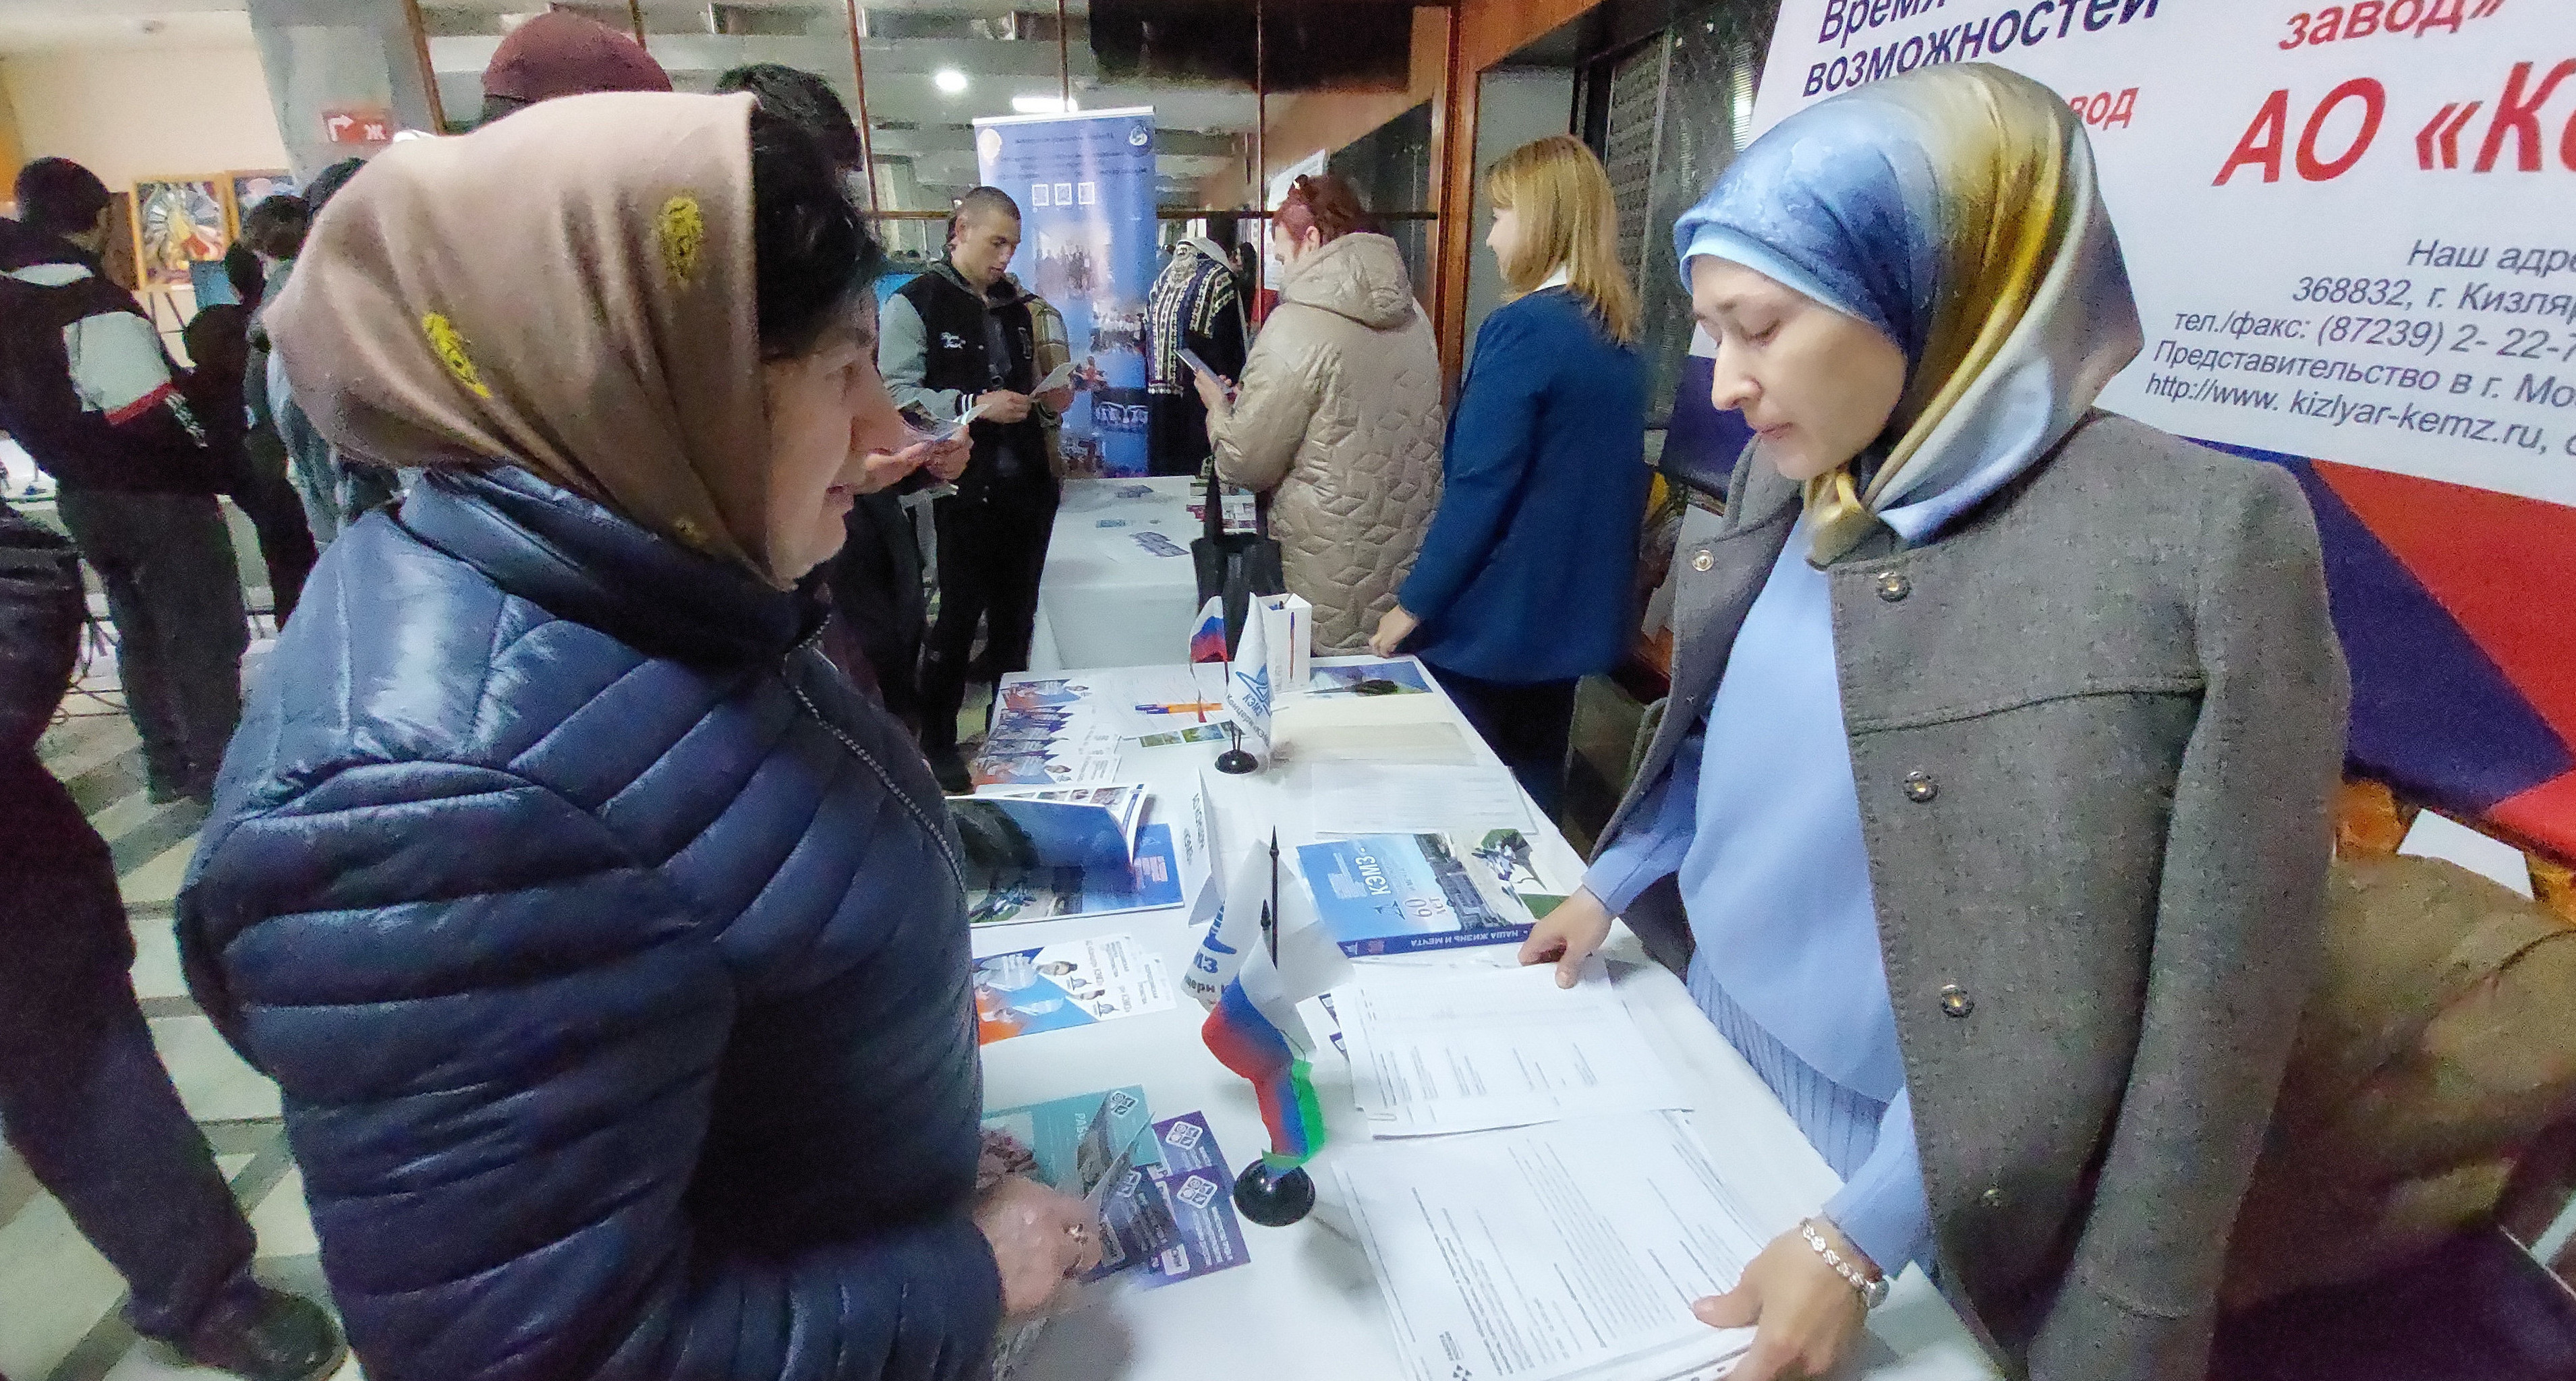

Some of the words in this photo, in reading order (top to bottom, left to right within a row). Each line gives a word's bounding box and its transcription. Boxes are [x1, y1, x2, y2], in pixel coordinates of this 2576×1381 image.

[2069, 87, 2140, 131] вод
[2211, 76, 2386, 187] АО
[2415, 58, 2576, 173] «К
[2407, 239, 2489, 268] Наш
[2293, 276, 2413, 311] 368832,
[2427, 287, 2446, 308] г.
[2175, 310, 2311, 340] тел./факс:
[2318, 315, 2444, 357] (87239)
[2153, 339, 2441, 391] Представительство
[2449, 373, 2473, 394] в
[2480, 376, 2503, 399] г.
[2513, 373, 2576, 407] Мо
[2145, 372, 2279, 412] http://www.
[2289, 388, 2548, 455] kizlyar-kemz.ru,
[1355, 855, 1392, 895] КЭМЗ
[1404, 899, 1432, 917] 60
[1410, 937, 1443, 947] МЕЧТА
[1454, 933, 1489, 943] ЖИЗНЬ
[1490, 929, 1518, 939] НАША
